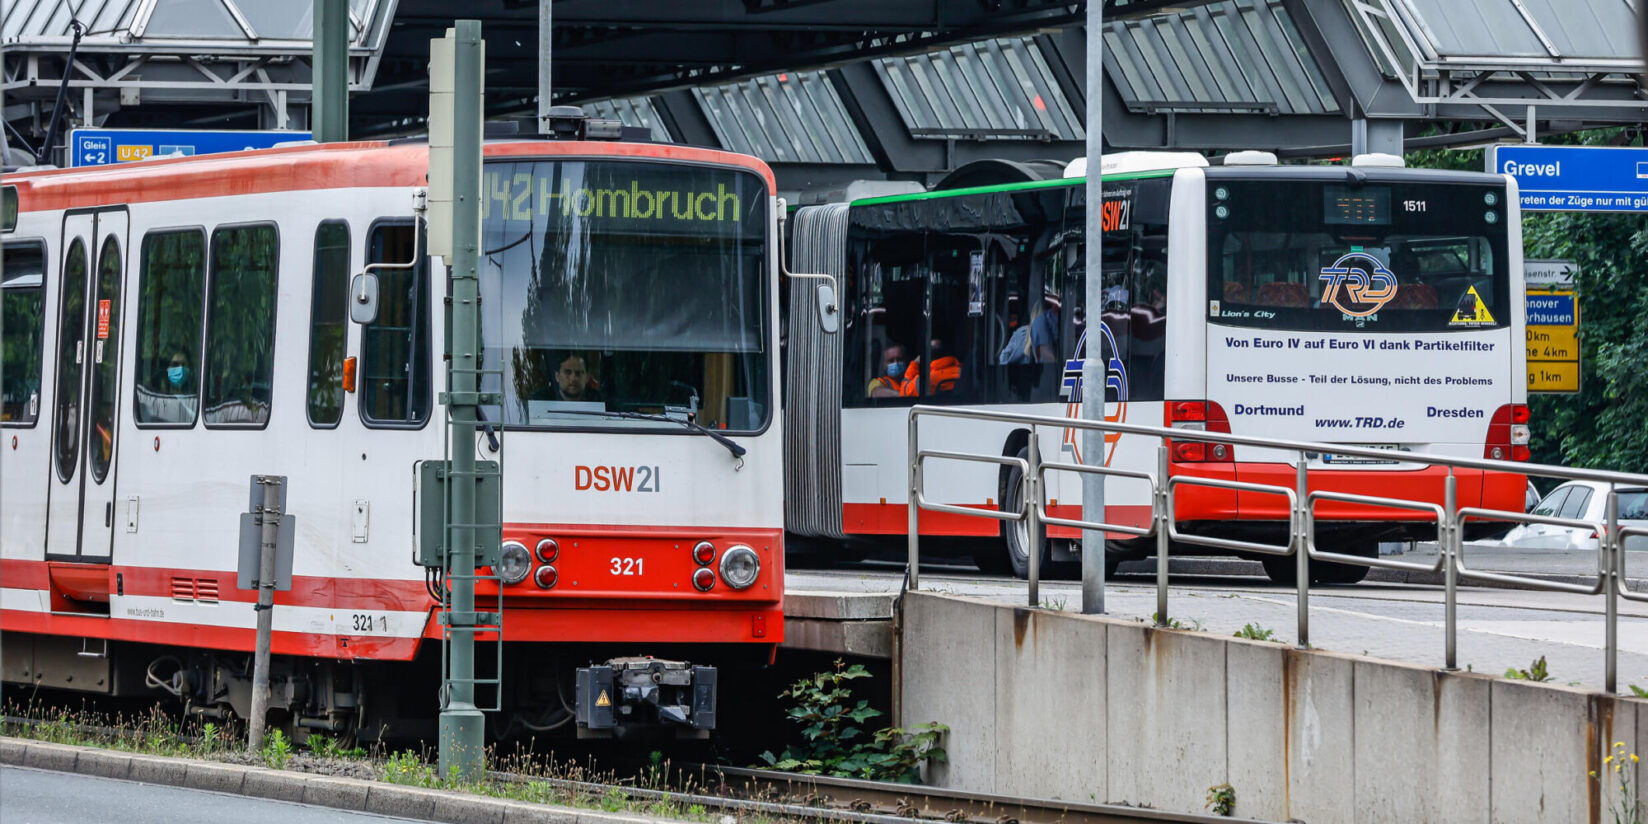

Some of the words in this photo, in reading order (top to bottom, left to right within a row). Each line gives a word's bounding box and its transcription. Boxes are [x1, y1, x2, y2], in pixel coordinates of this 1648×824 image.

[84, 141, 107, 150] Gleis
[97, 152, 105, 164] 2
[1503, 160, 1560, 177] Grevel
[540, 177, 739, 221] Hombruch
[1520, 195, 1546, 205] reten
[1549, 195, 1565, 205] der
[1568, 195, 1593, 208] Züge
[1596, 198, 1613, 206] nur
[1616, 196, 1631, 206] mit
[1634, 196, 1648, 208] gü
[1403, 200, 1426, 212] 1511
[1319, 267, 1397, 303] TRD
[1253, 310, 1276, 319] City
[1526, 312, 1572, 323] rhausen
[1225, 337, 1249, 348] Von
[1253, 338, 1283, 349] Euro
[1287, 338, 1300, 349] IV
[1304, 338, 1325, 349] auf
[1329, 339, 1359, 349] Euro
[1363, 339, 1375, 350] VI
[1379, 340, 1410, 350] dank
[1414, 340, 1495, 351] Partikelfilter
[1226, 373, 1263, 383] Unsere
[1266, 374, 1298, 383] Busse
[1309, 375, 1327, 383] Teil
[1330, 375, 1348, 384] der
[1351, 375, 1391, 385] Lösung,
[1394, 376, 1420, 385] nicht
[1423, 376, 1442, 385] des
[1445, 376, 1493, 385] Problems
[1234, 404, 1304, 416] Dortmund
[1426, 406, 1484, 418] Dresden
[1315, 417, 1405, 429] www.TRD.de
[610, 557, 643, 576] 321
[353, 614, 373, 631] 321
